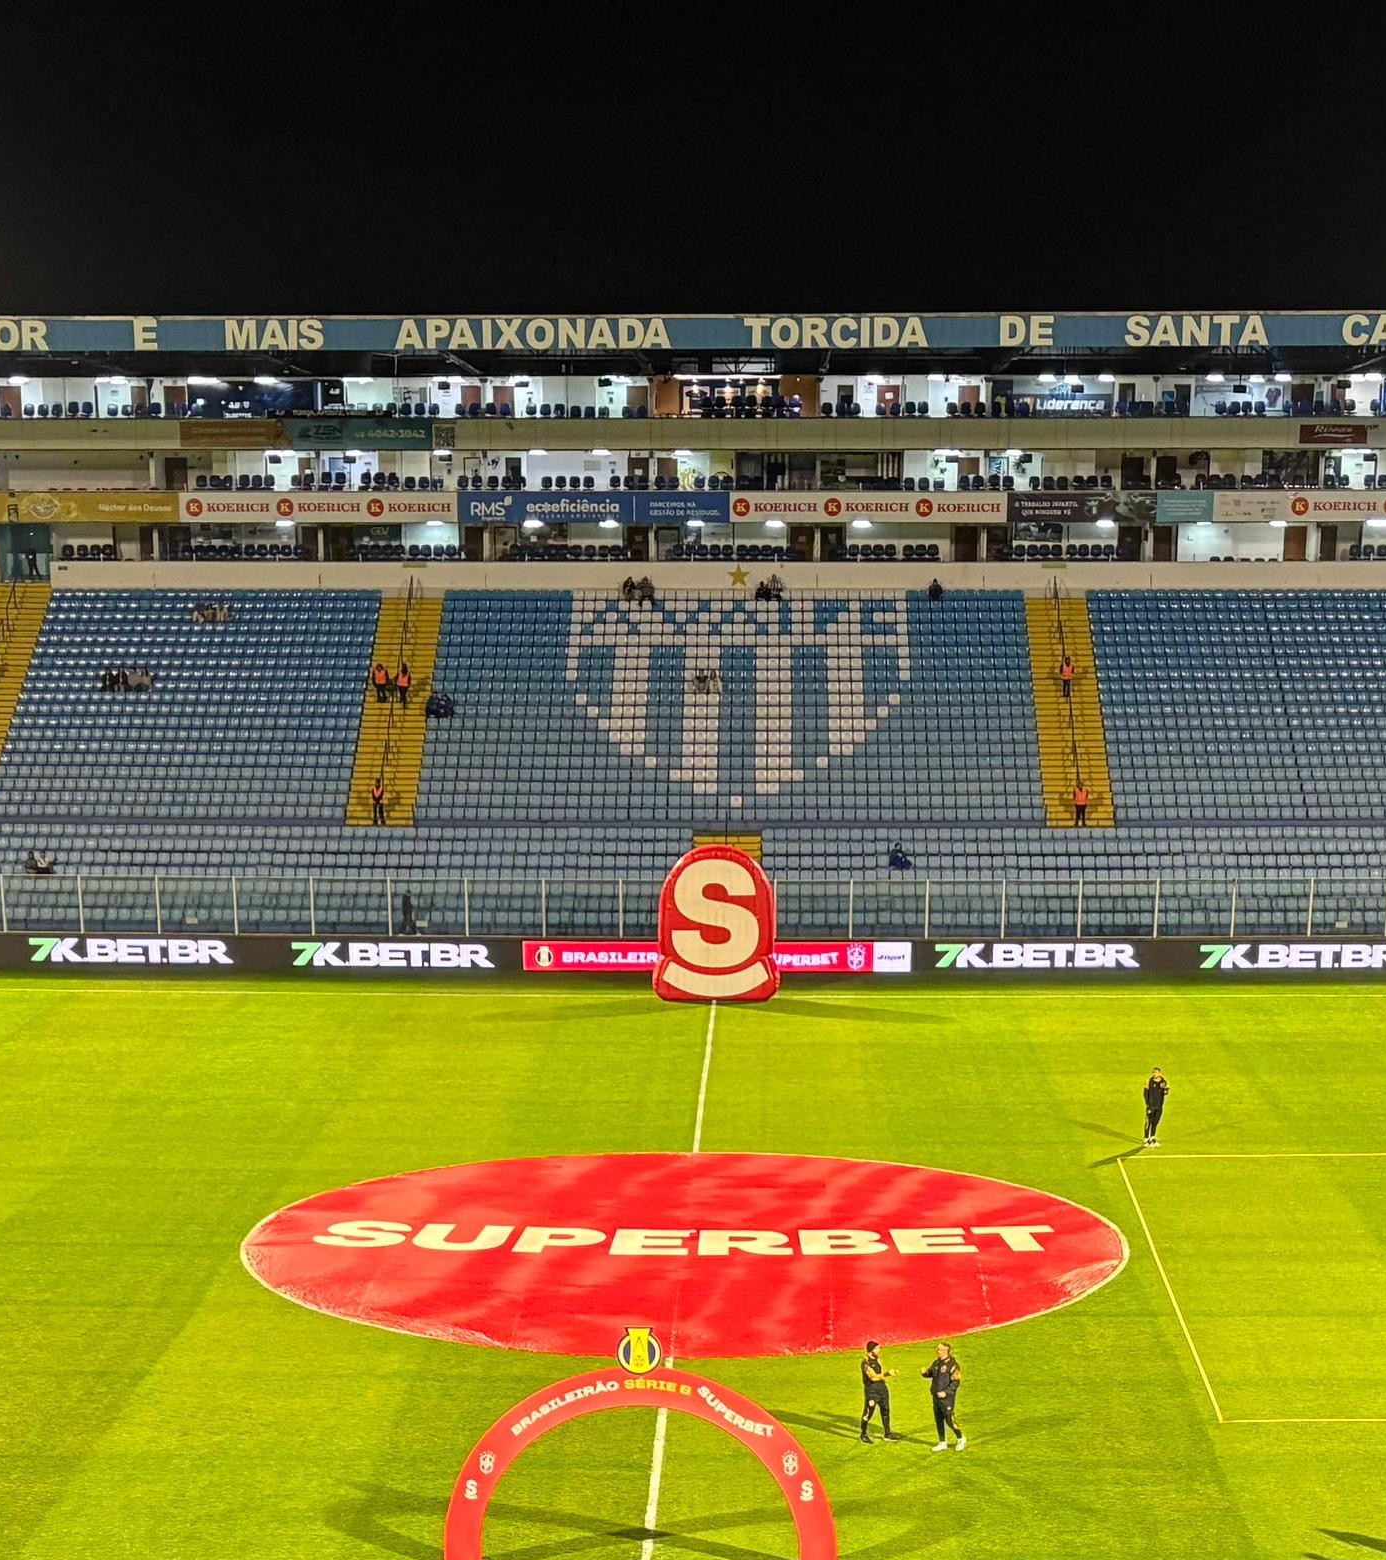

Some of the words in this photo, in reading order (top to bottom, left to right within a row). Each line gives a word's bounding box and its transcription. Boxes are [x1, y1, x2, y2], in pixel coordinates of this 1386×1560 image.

[133, 318, 158, 351] E
[224, 319, 324, 350] MAIS
[396, 318, 672, 350] APAIXONADA
[743, 316, 928, 349] TORCIDA
[999, 315, 1054, 346] DE
[1124, 315, 1270, 347] SANTA
[207, 503, 270, 513] KOERICH
[298, 502, 360, 513] KOERICH
[388, 502, 452, 513] KOERICH
[470, 501, 505, 516] RMS
[754, 502, 817, 512] KOERICH
[845, 502, 909, 512] KOERICH
[937, 503, 1001, 513] KOERICH
[1314, 501, 1377, 512] KOERICH
[671, 858, 759, 969] S
[312, 1219, 1055, 1256] SUPERBET
[511, 1380, 620, 1437] BRASILEIRÃO
[624, 1376, 677, 1393] SÉRIE
[679, 1383, 691, 1395] B
[697, 1385, 774, 1438] SUPERBET
